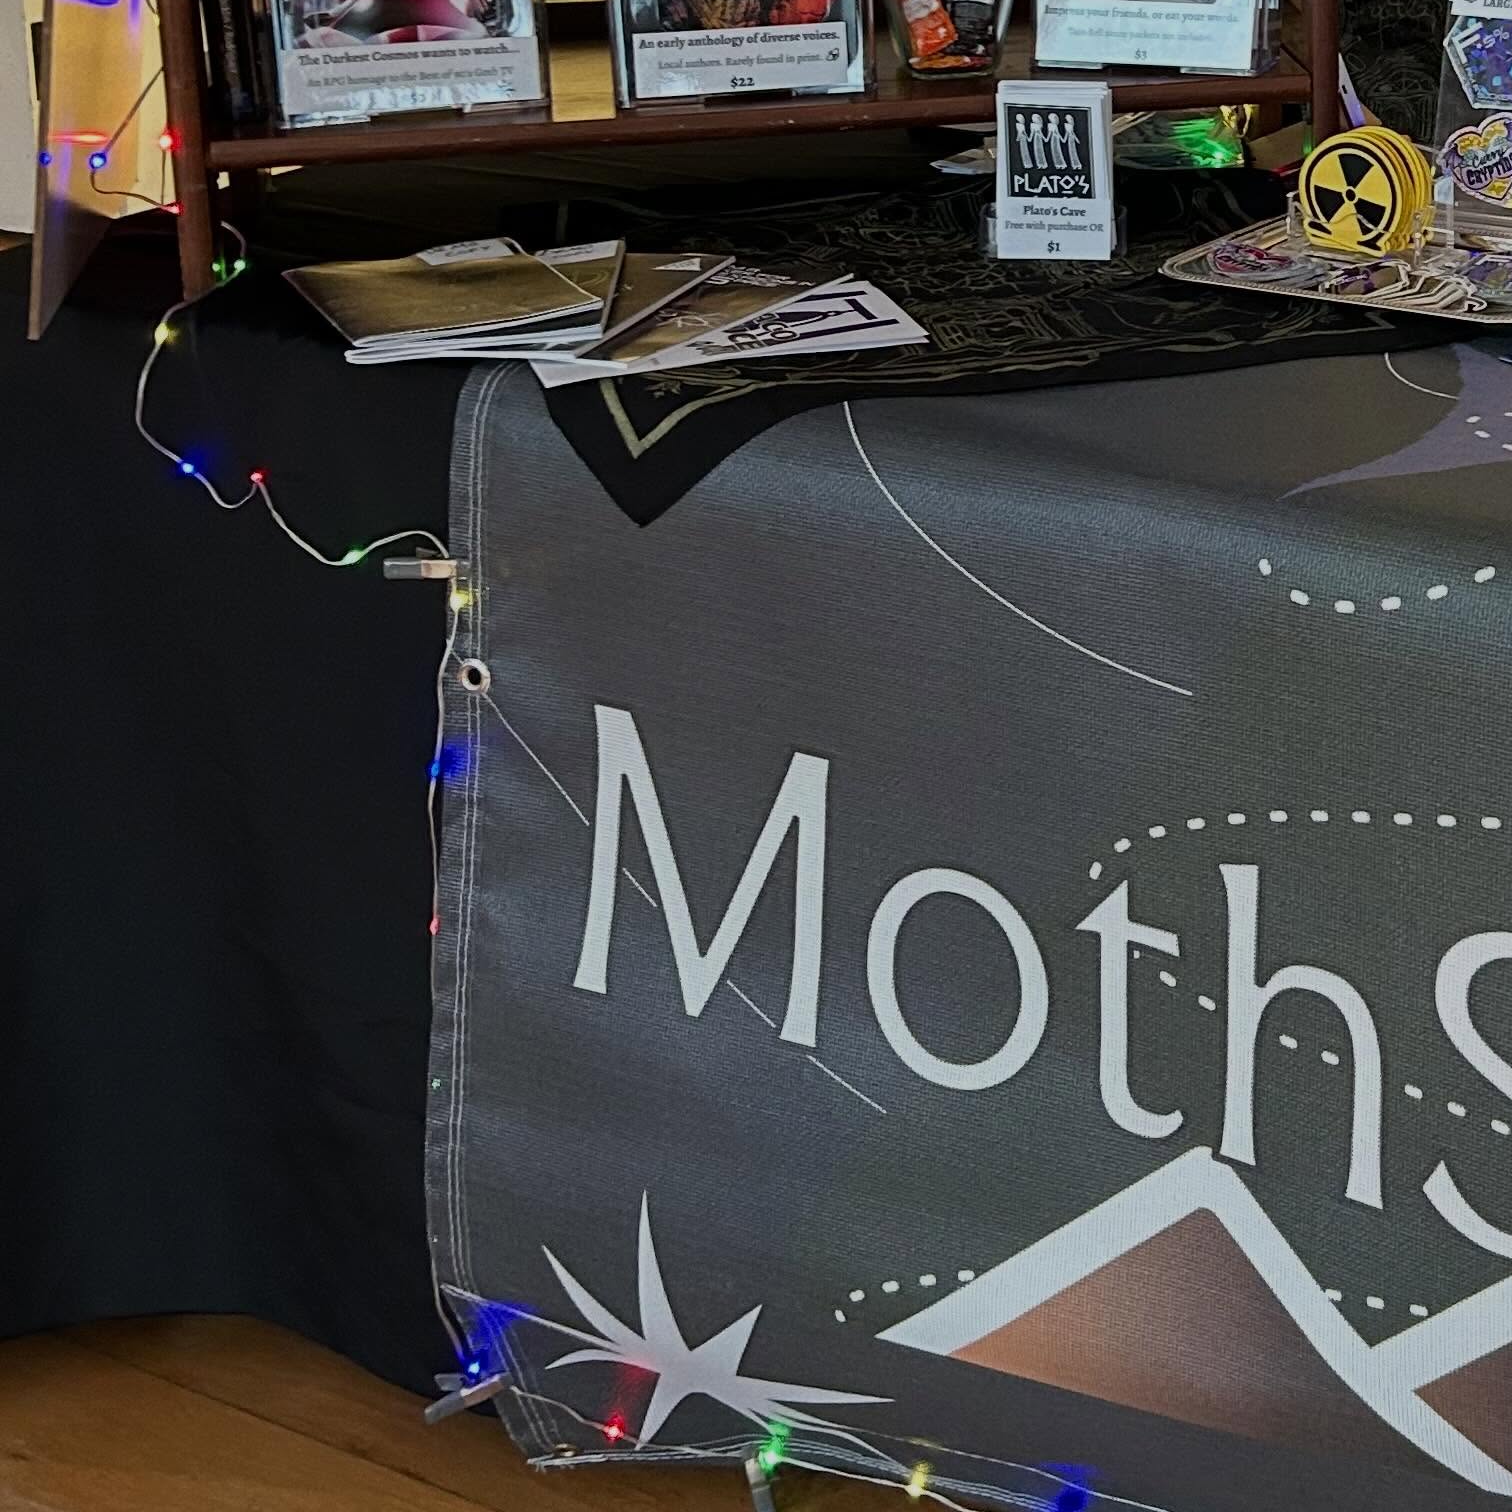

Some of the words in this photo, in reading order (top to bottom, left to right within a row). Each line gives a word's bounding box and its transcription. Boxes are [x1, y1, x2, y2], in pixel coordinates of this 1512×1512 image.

[638, 39, 655, 50] An
[657, 37, 686, 50] early
[687, 35, 744, 48] anthology
[746, 33, 759, 44] of
[760, 32, 801, 43] diverse
[802, 29, 840, 41] voices.
[730, 76, 755, 89] $22
[1013, 171, 1090, 195] PLATO'S
[1023, 204, 1058, 218] Plato's
[1060, 206, 1087, 217] Cave
[1047, 239, 1061, 254] $1
